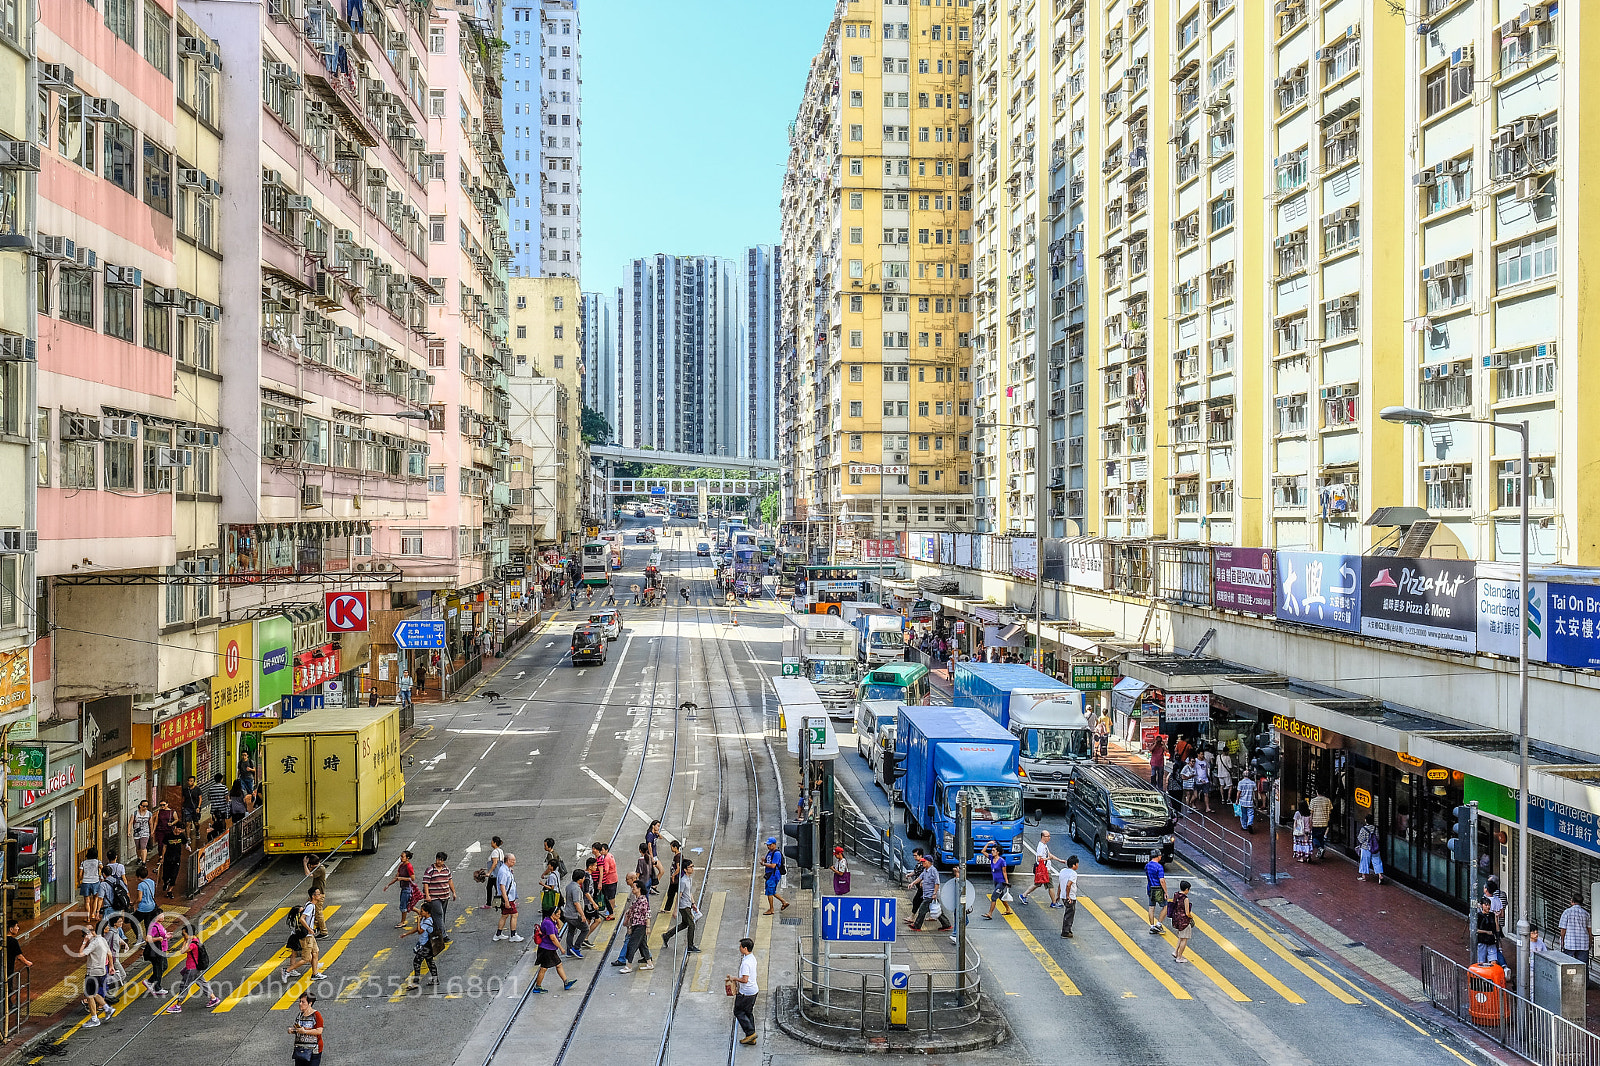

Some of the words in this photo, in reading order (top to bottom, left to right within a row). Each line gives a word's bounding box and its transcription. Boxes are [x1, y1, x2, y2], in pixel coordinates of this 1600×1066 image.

[1398, 567, 1434, 596] Pizza
[1434, 569, 1465, 598] Hut
[1483, 582, 1520, 600] Standard
[1405, 601, 1423, 616] Pizza
[1424, 603, 1430, 616] &
[1431, 603, 1451, 618] More
[1480, 599, 1520, 618] Chartered
[1551, 594, 1566, 610] Tai
[1568, 595, 1584, 612] On
[1586, 597, 1600, 614] Br
[1489, 620, 1520, 636] 渣打銀行
[1272, 714, 1289, 731] cafe
[1290, 718, 1300, 735] de
[1300, 722, 1321, 742] coral
[362, 737, 371, 759] BS
[323, 754, 341, 772] 時
[68, 763, 76, 785] K
